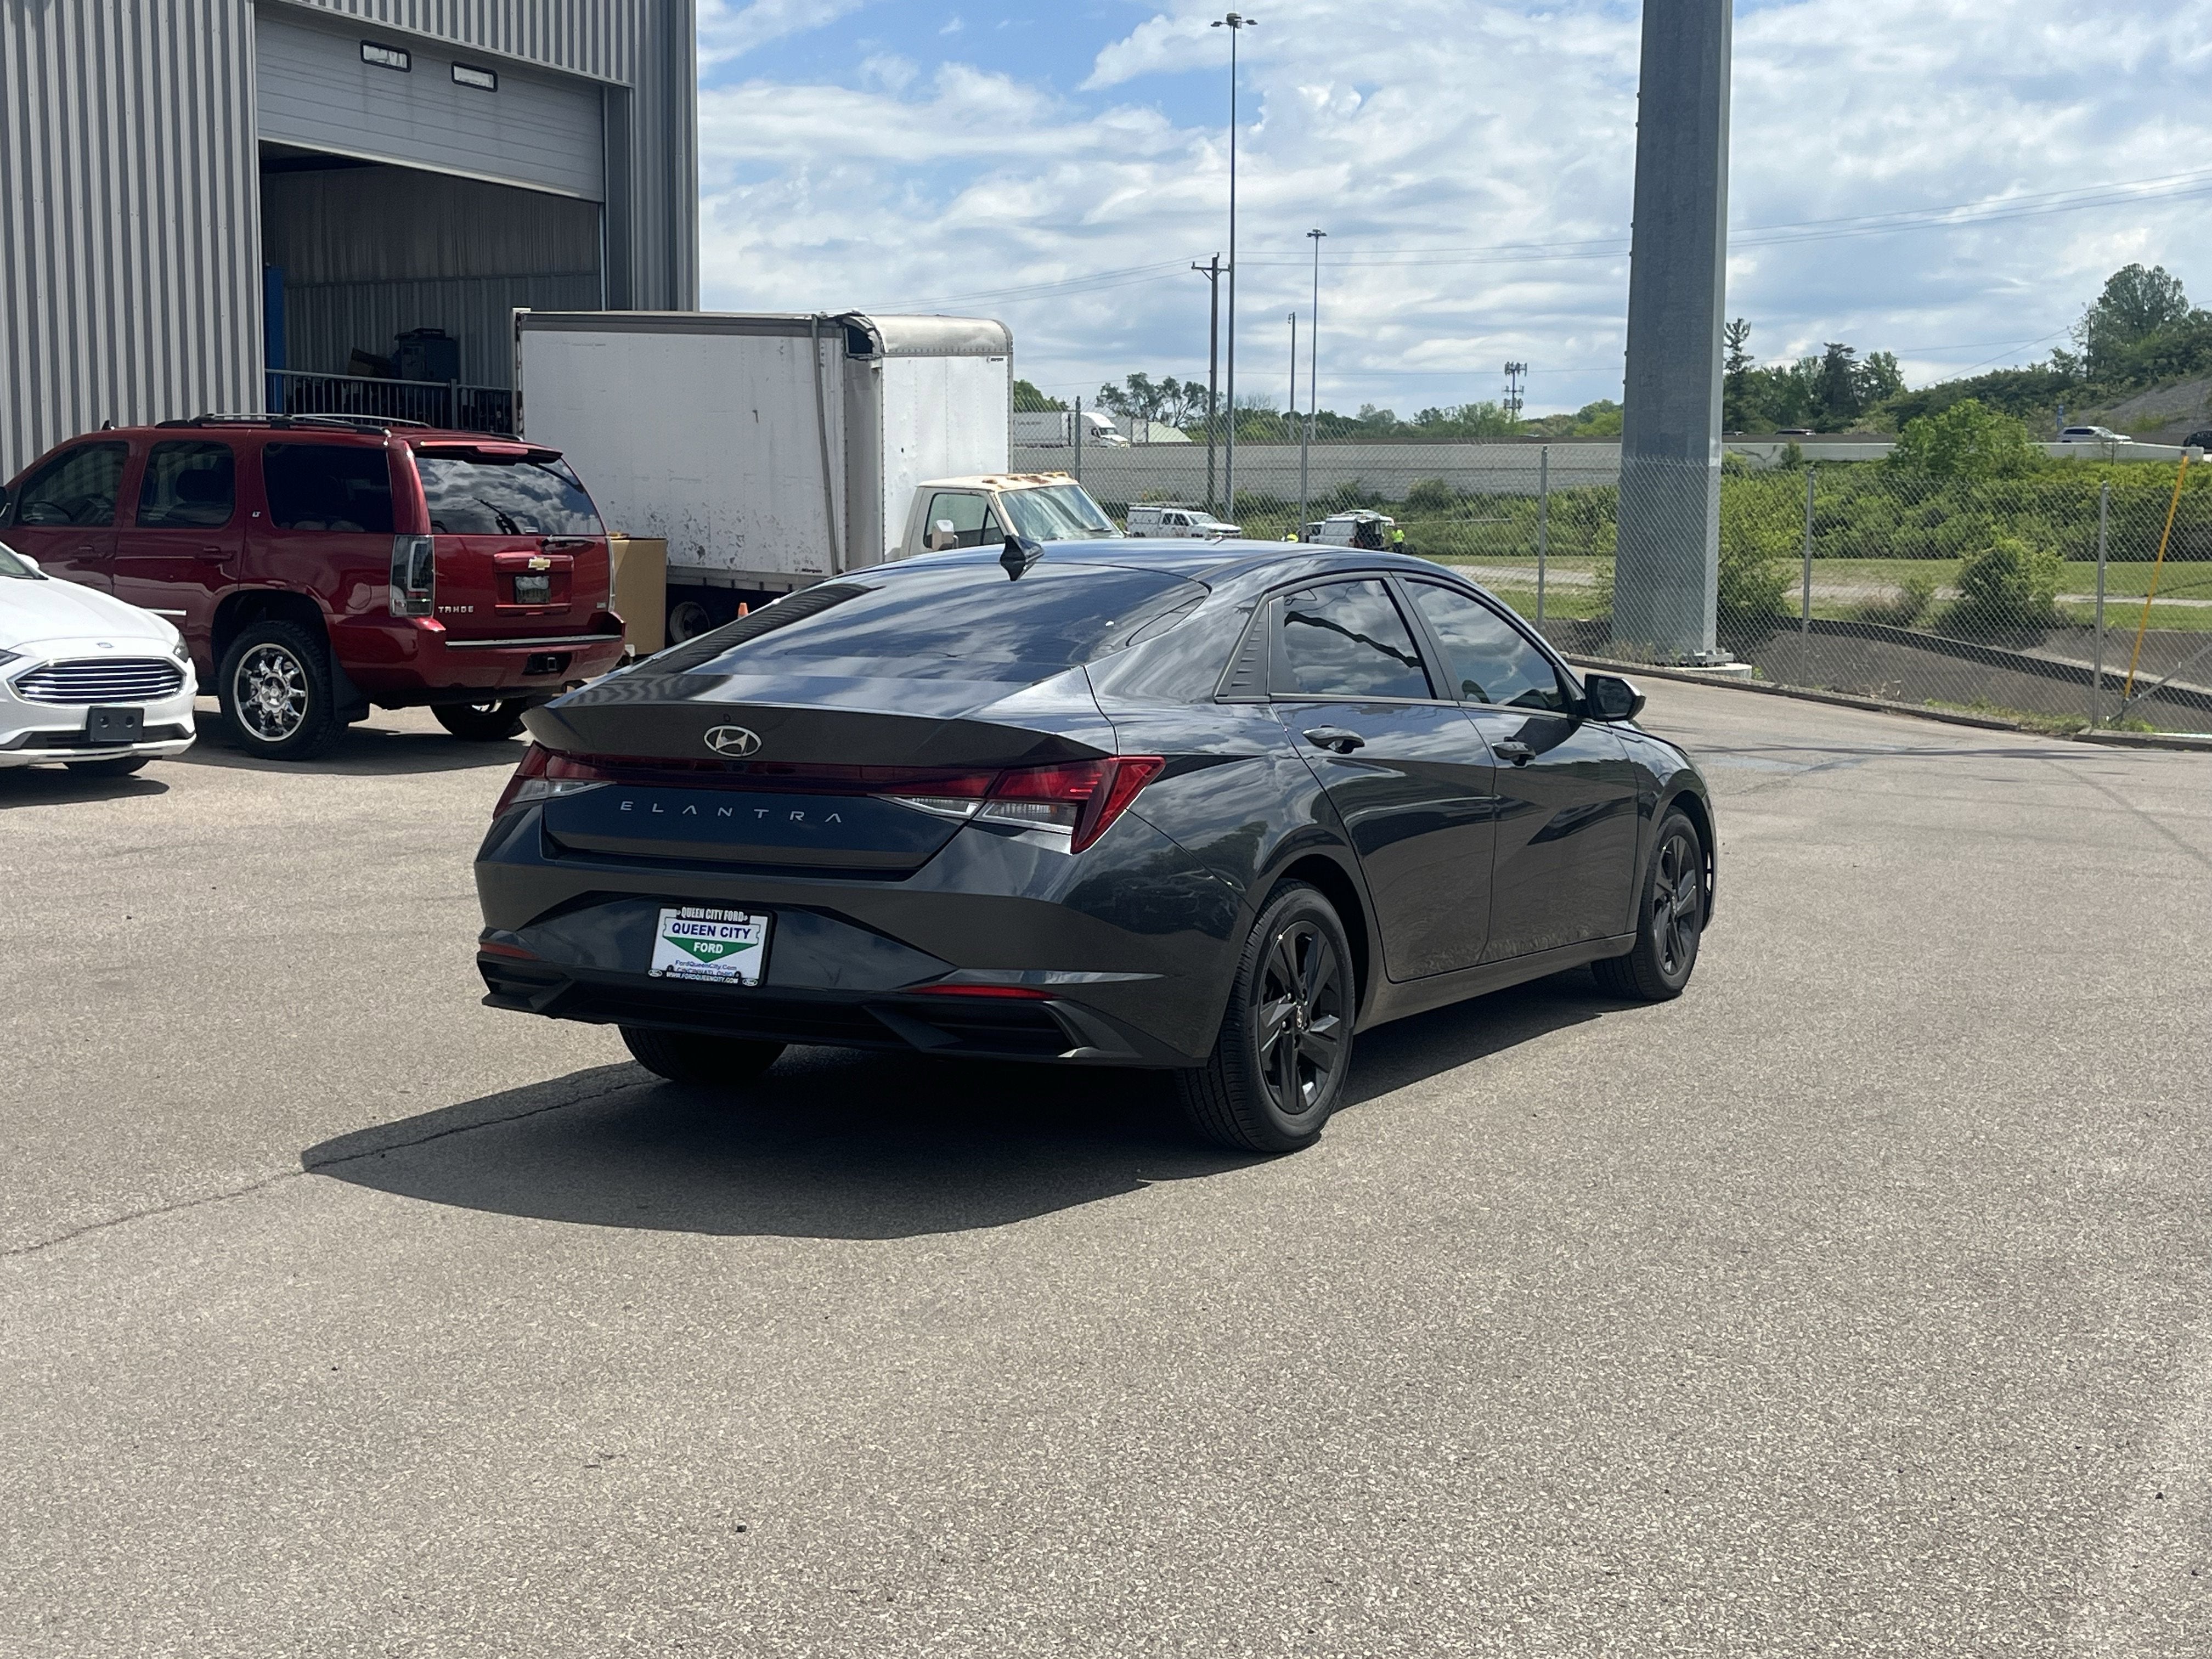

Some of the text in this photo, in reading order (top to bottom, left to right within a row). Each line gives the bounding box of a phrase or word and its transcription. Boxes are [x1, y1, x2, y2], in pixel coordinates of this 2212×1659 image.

[620, 801, 842, 823] ELANTRA
[681, 907, 744, 922] QUEEN CITY FORD
[672, 923, 752, 939] QUEEN CITY
[693, 942, 724, 953] FORD
